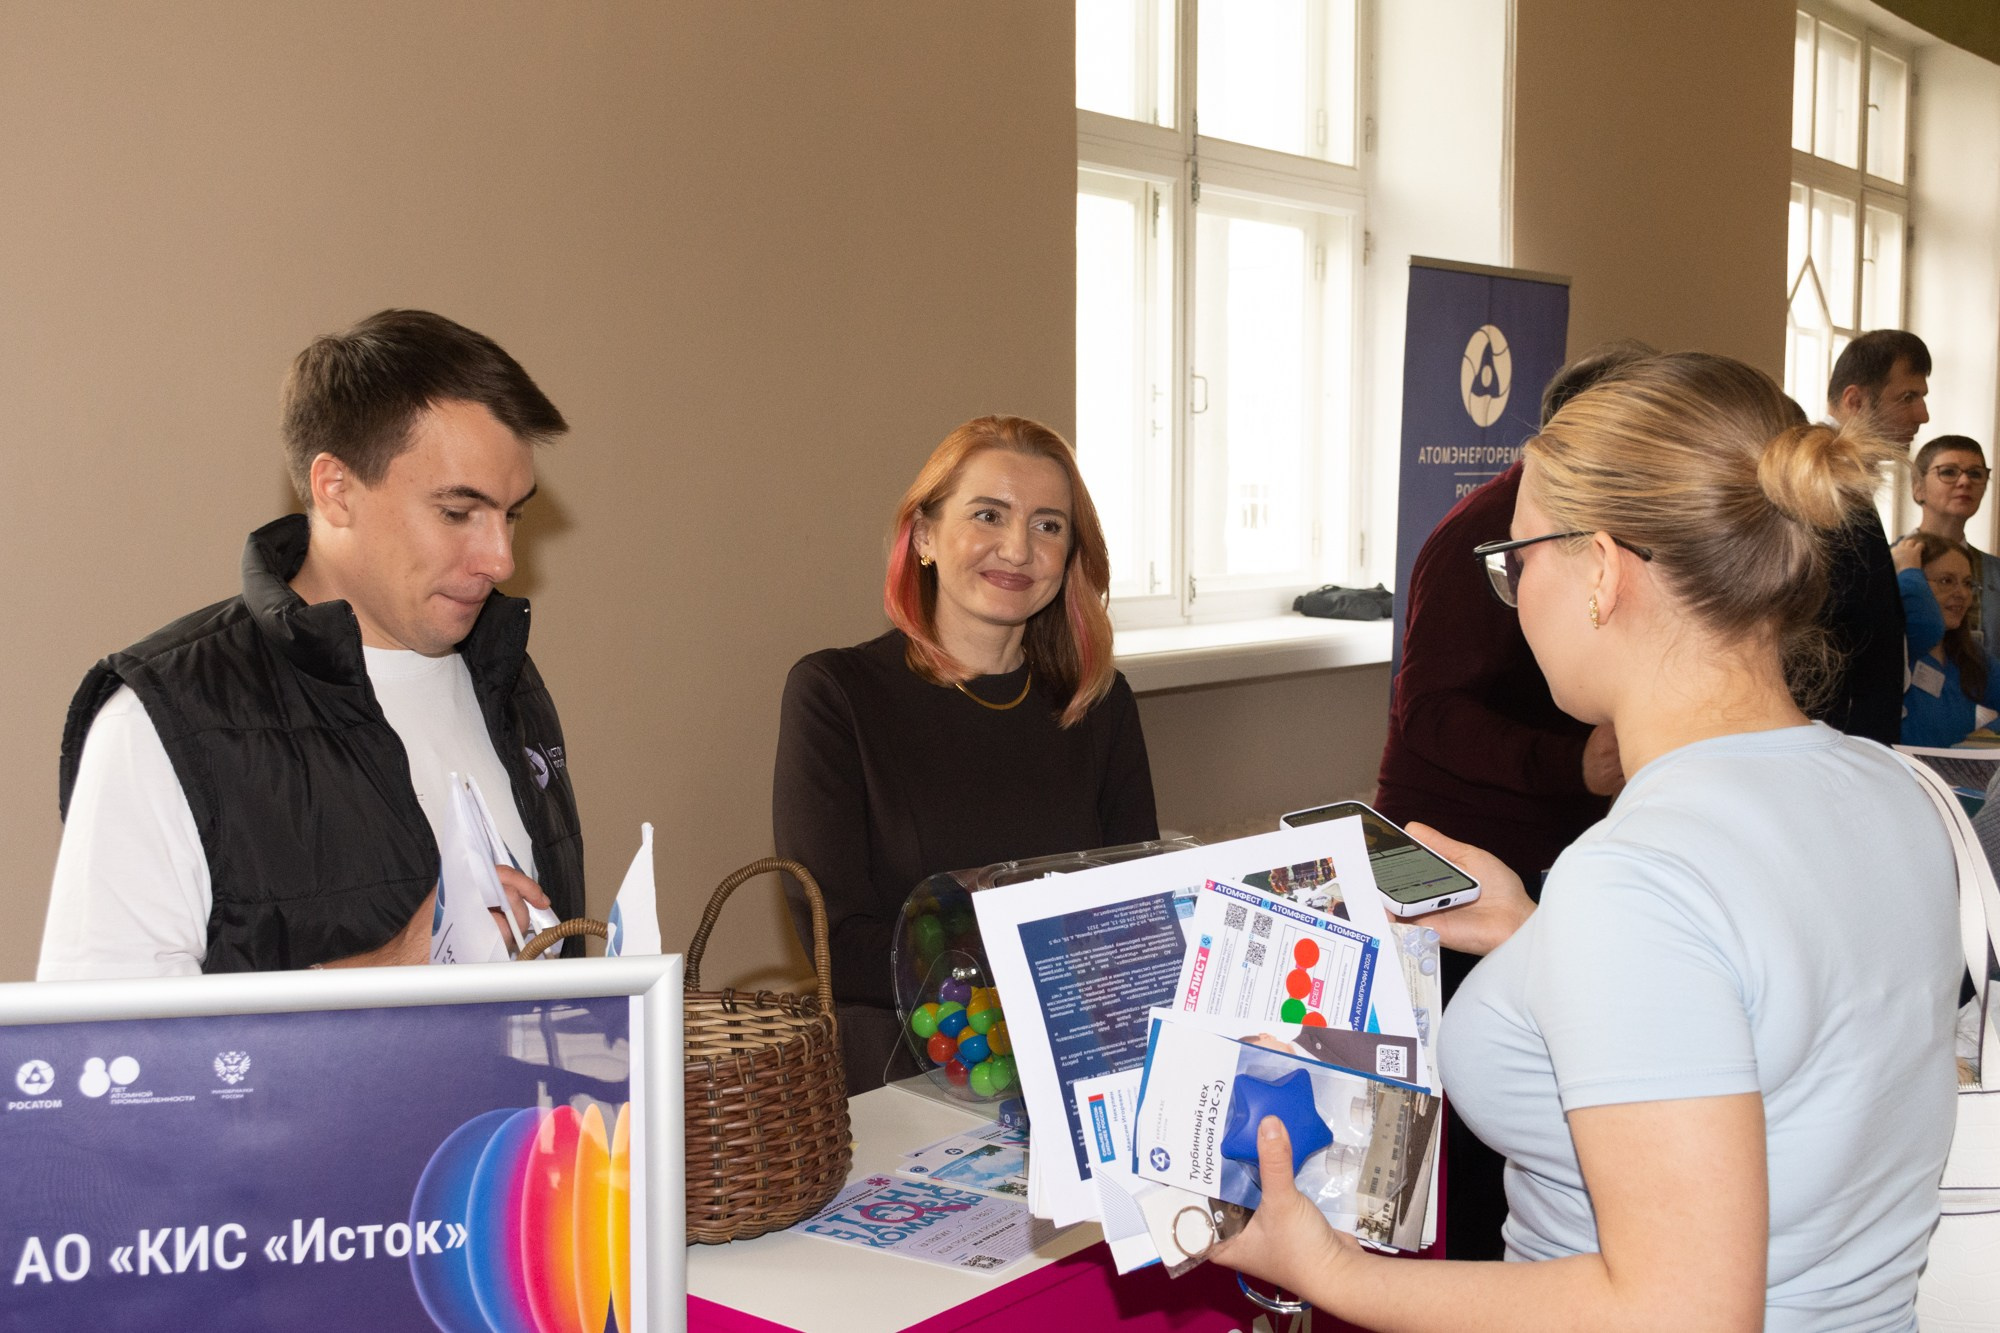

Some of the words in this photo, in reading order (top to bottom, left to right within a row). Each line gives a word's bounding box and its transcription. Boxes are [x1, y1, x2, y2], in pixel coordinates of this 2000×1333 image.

[1215, 883, 1261, 905] АТОМФЕСТ
[1272, 902, 1316, 924] АТОМФЕСТ
[1328, 923, 1370, 943] АТОМФЕСТ
[1185, 952, 1206, 1011] ЕК-ЛИСТ
[1311, 982, 1320, 1006] ВСЕГО
[1354, 1016, 1360, 1026] НА
[1357, 970, 1369, 1015] АТОМПРОФИ
[1364, 954, 1372, 969] 2025
[8, 1100, 62, 1110] РОСАТОМ
[111, 1096, 196, 1104] ПРОМЫШЛЕННОСТИ
[1109, 1091, 1118, 1121] Никулин
[1208, 1080, 1226, 1125] АЭС-2)
[1098, 1105, 1106, 1128] РОССИЯ
[1098, 1132, 1106, 1156] СИЛЬНЕЕ
[1102, 1129, 1111, 1155] СИЛЬНЕЕ
[1190, 1110, 1204, 1180] Турбинный
[1199, 1084, 1209, 1106] цех
[1202, 1128, 1215, 1184] (Курской
[805, 1181, 936, 1234] СТАНЬ
[14, 1234, 91, 1286] АО
[109, 1222, 248, 1276] «КИС
[264, 1217, 468, 1265] «Исток»
